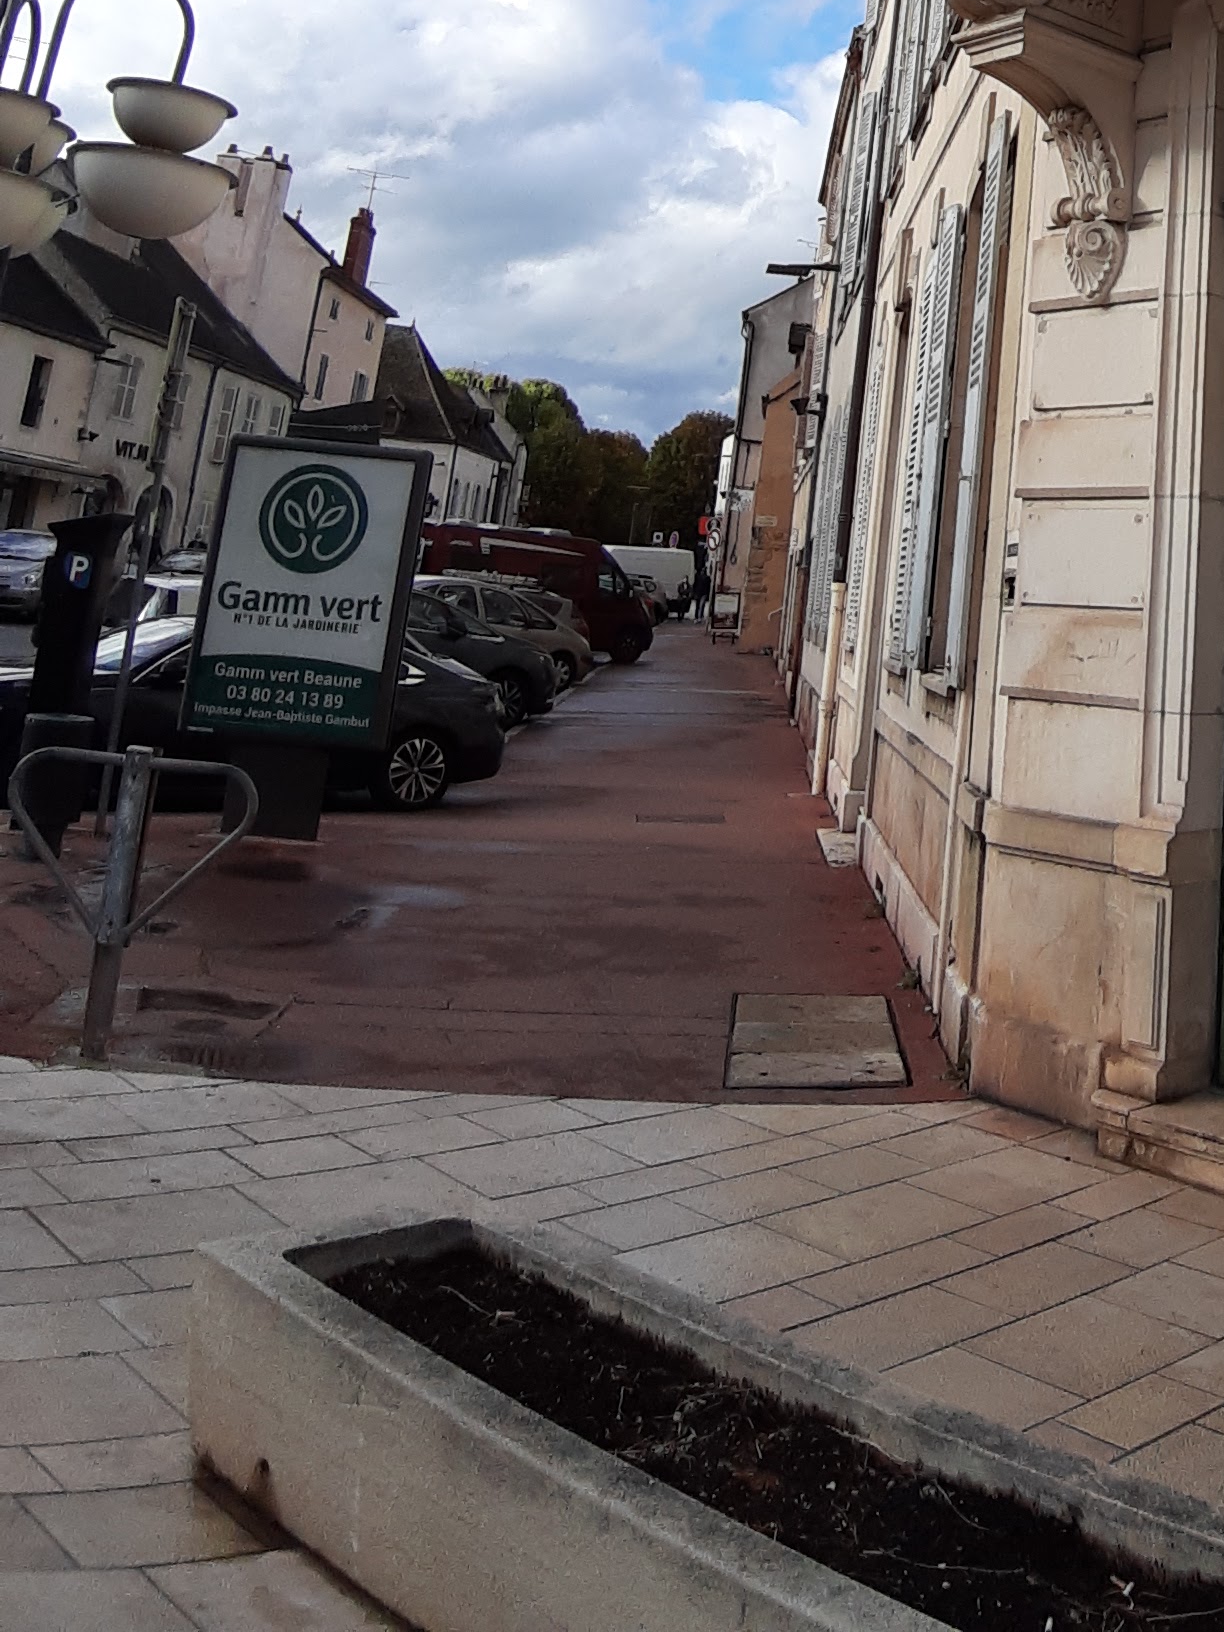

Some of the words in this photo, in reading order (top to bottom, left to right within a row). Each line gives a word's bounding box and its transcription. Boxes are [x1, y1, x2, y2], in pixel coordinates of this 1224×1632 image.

[69, 555, 89, 582] P
[218, 581, 310, 616] Gamm
[320, 594, 382, 622] vert
[258, 615, 271, 626] DE
[276, 617, 288, 628] LA
[293, 619, 359, 634] JARDINERIE
[215, 662, 265, 680] Gamm
[270, 669, 299, 684] vert
[304, 670, 362, 689] Beaune
[227, 685, 247, 700] 03
[251, 687, 270, 702] 80
[275, 690, 294, 705] 24
[301, 691, 318, 706] 13
[323, 694, 344, 709] 89
[194, 702, 241, 717] Impasse
[244, 707, 323, 724] Jean-Baptiste
[325, 714, 370, 728] Gambut
